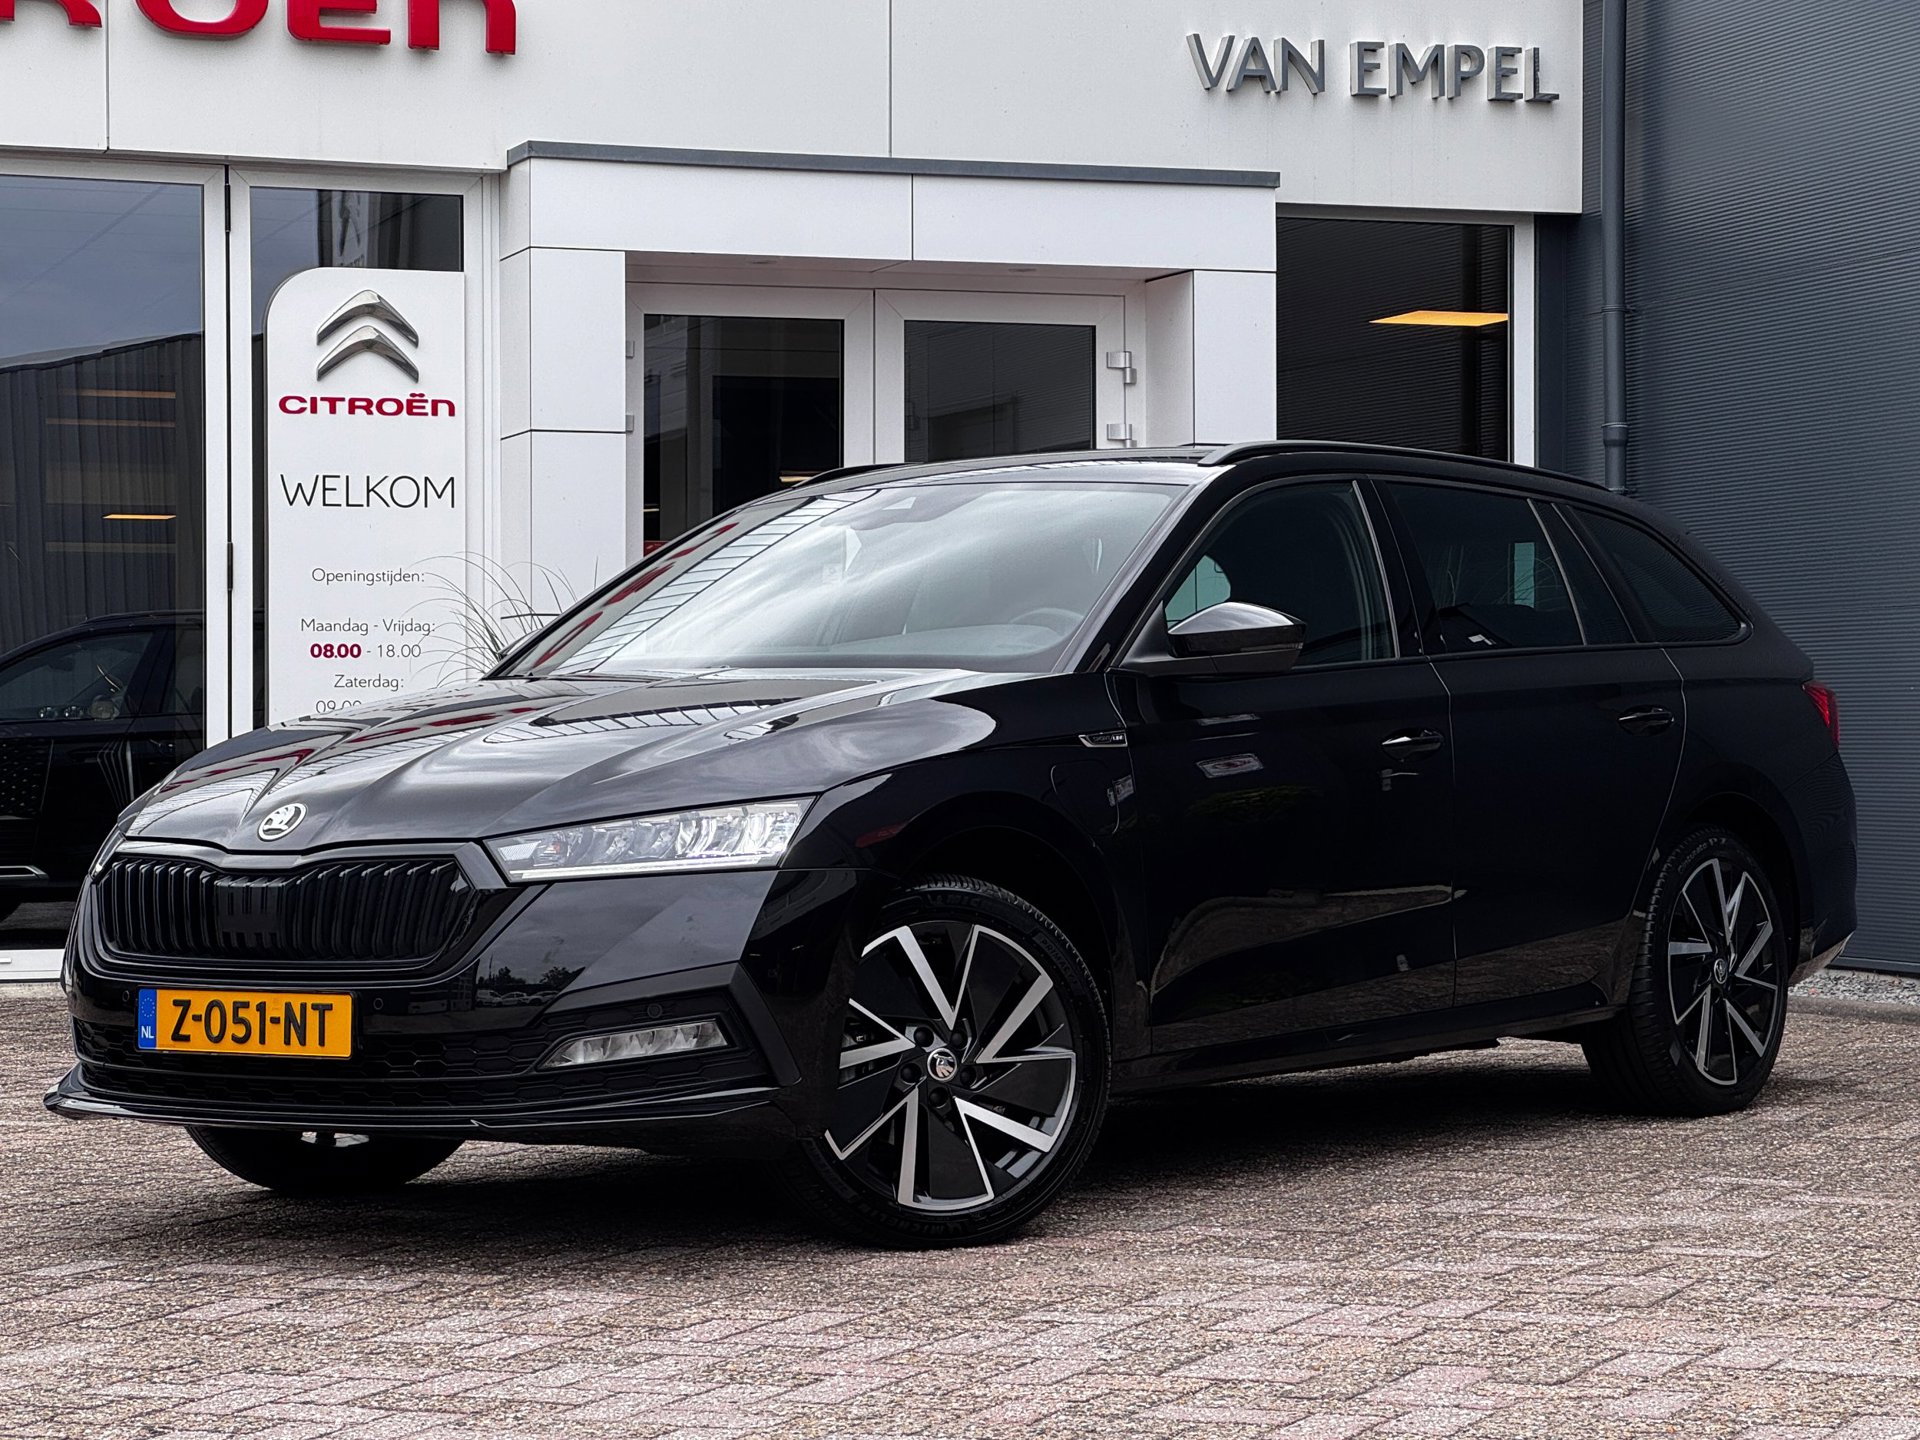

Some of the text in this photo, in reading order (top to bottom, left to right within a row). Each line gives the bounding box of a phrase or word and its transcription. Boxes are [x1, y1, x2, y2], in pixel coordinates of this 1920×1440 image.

[1186, 33, 1560, 102] VAN EMPEL
[280, 474, 455, 508] WELKOM
[311, 567, 425, 586] Openingstijden:
[301, 617, 369, 636] Maandag
[382, 618, 435, 636] Vrijdag:
[310, 643, 362, 659] 08.00
[377, 644, 421, 658] 18.00
[334, 673, 404, 691] Zaterdag:
[141, 1026, 154, 1039] NL
[171, 999, 333, 1047] Z-051-NT
